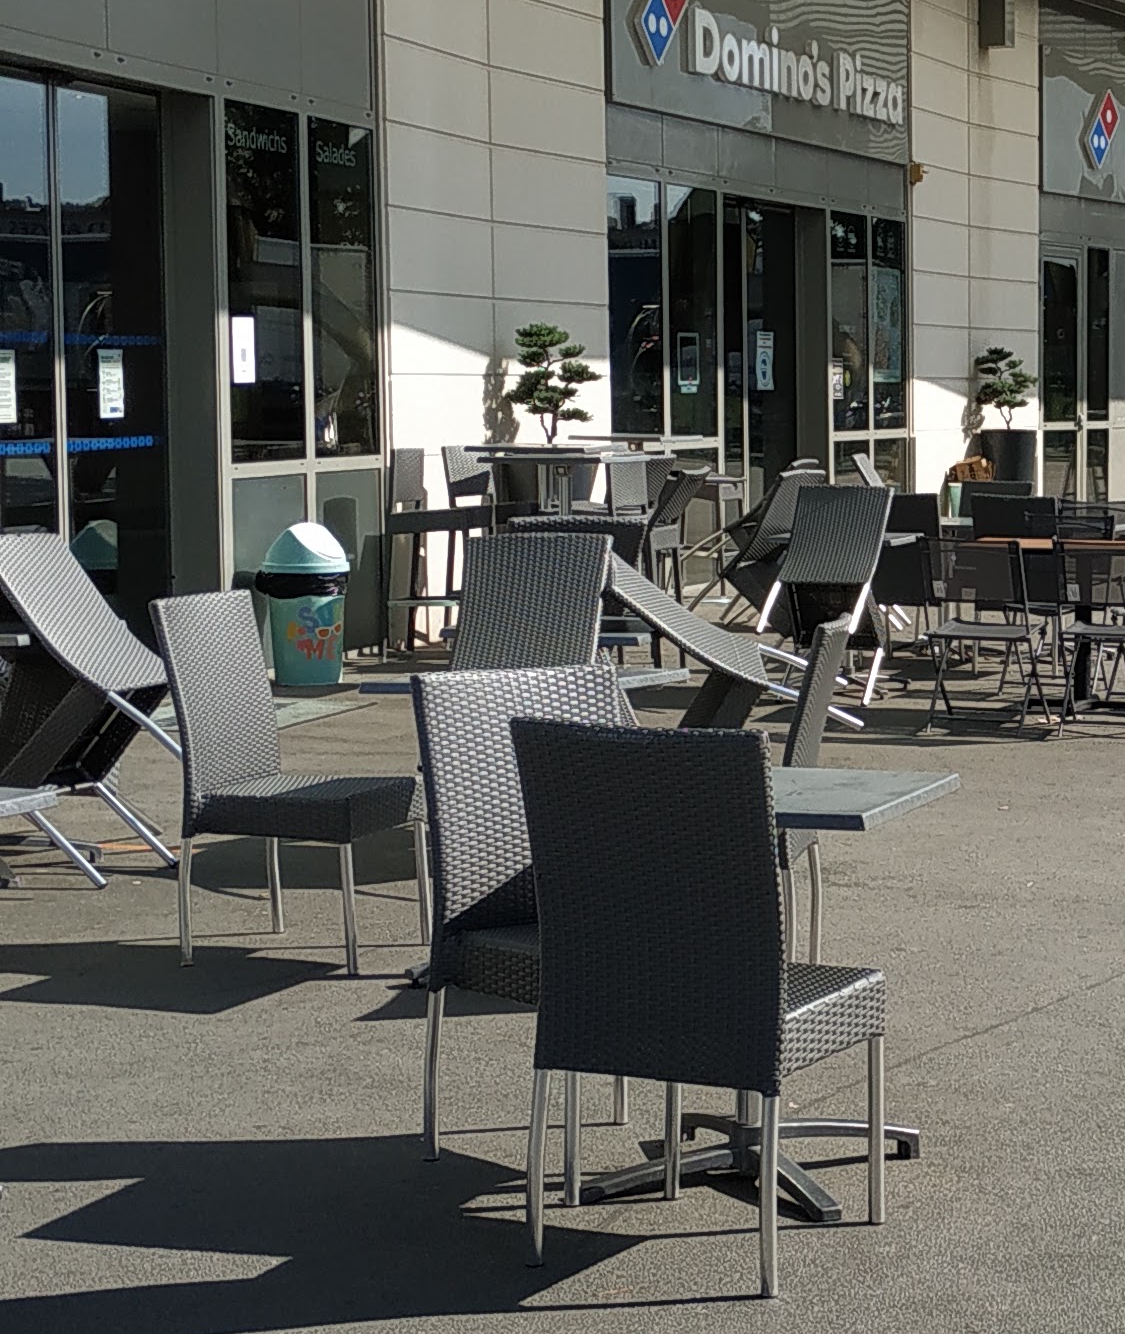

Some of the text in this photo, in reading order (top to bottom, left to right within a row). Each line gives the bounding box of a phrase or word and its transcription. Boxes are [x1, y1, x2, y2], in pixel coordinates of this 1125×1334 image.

[692, 6, 904, 125] Domino's Pizza
[226, 122, 288, 154] Sandwichs
[315, 140, 357, 167] Salades
